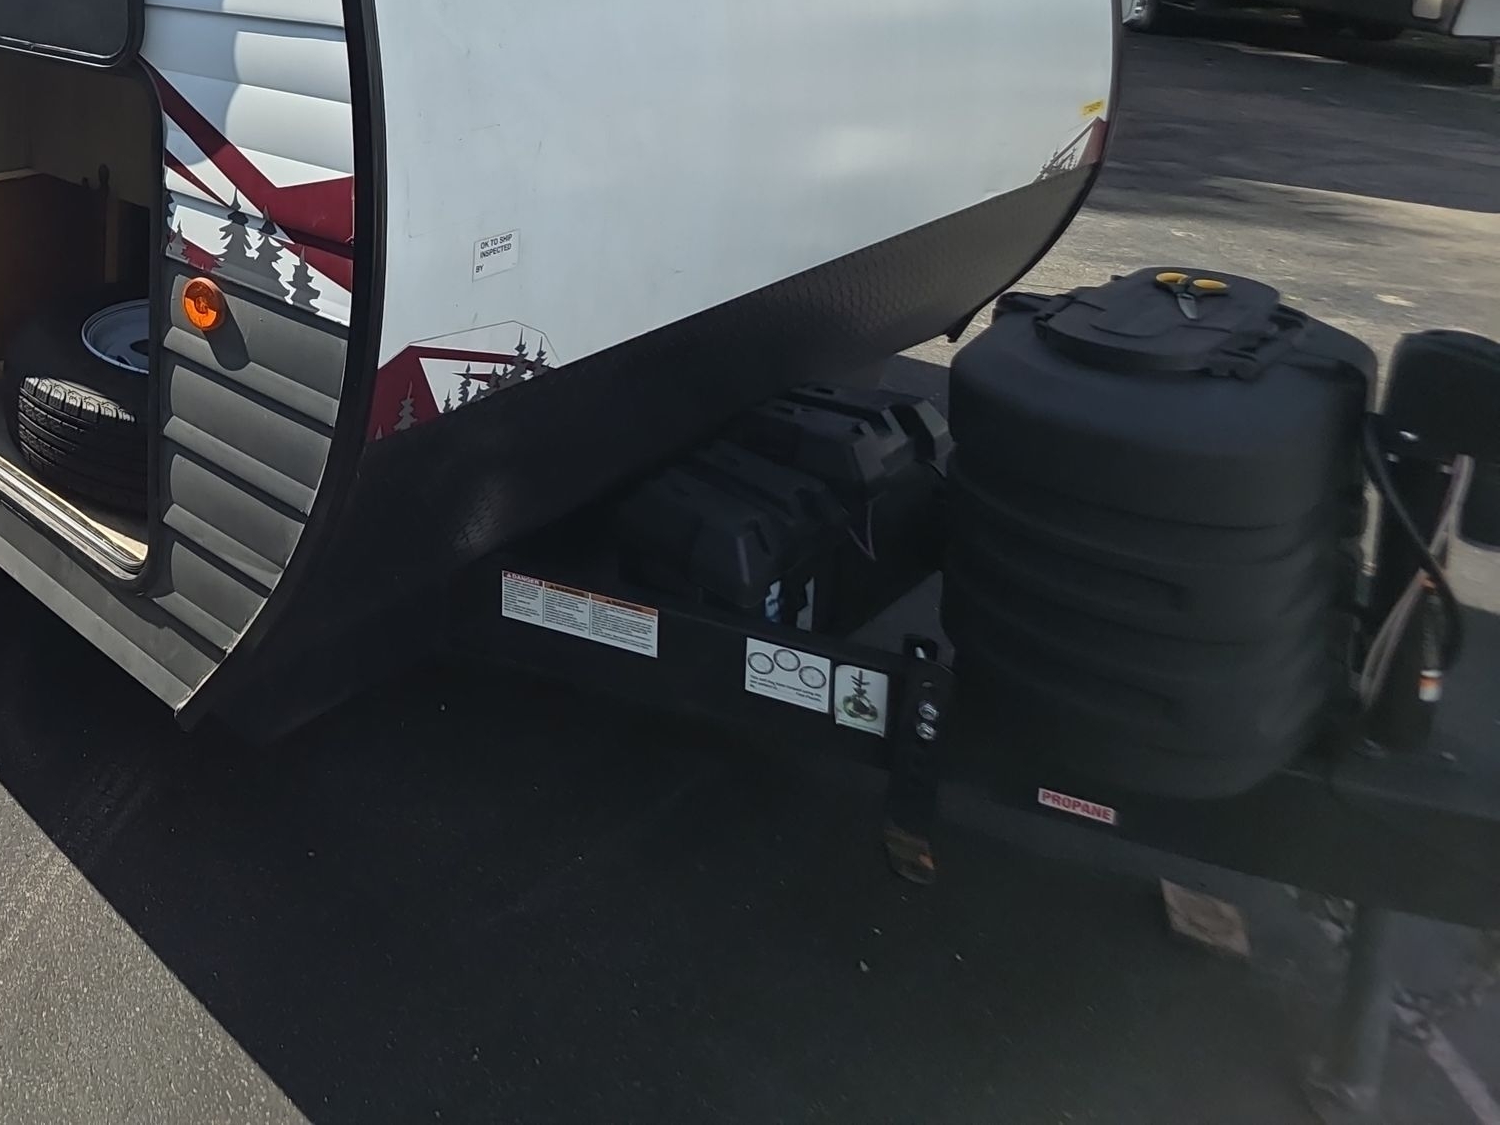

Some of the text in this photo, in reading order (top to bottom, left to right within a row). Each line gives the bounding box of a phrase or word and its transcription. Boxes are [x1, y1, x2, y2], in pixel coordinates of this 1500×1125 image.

[480, 242, 512, 259] INSPECTED
[511, 573, 540, 586] DANGER
[1041, 789, 1113, 821] PROPANE
